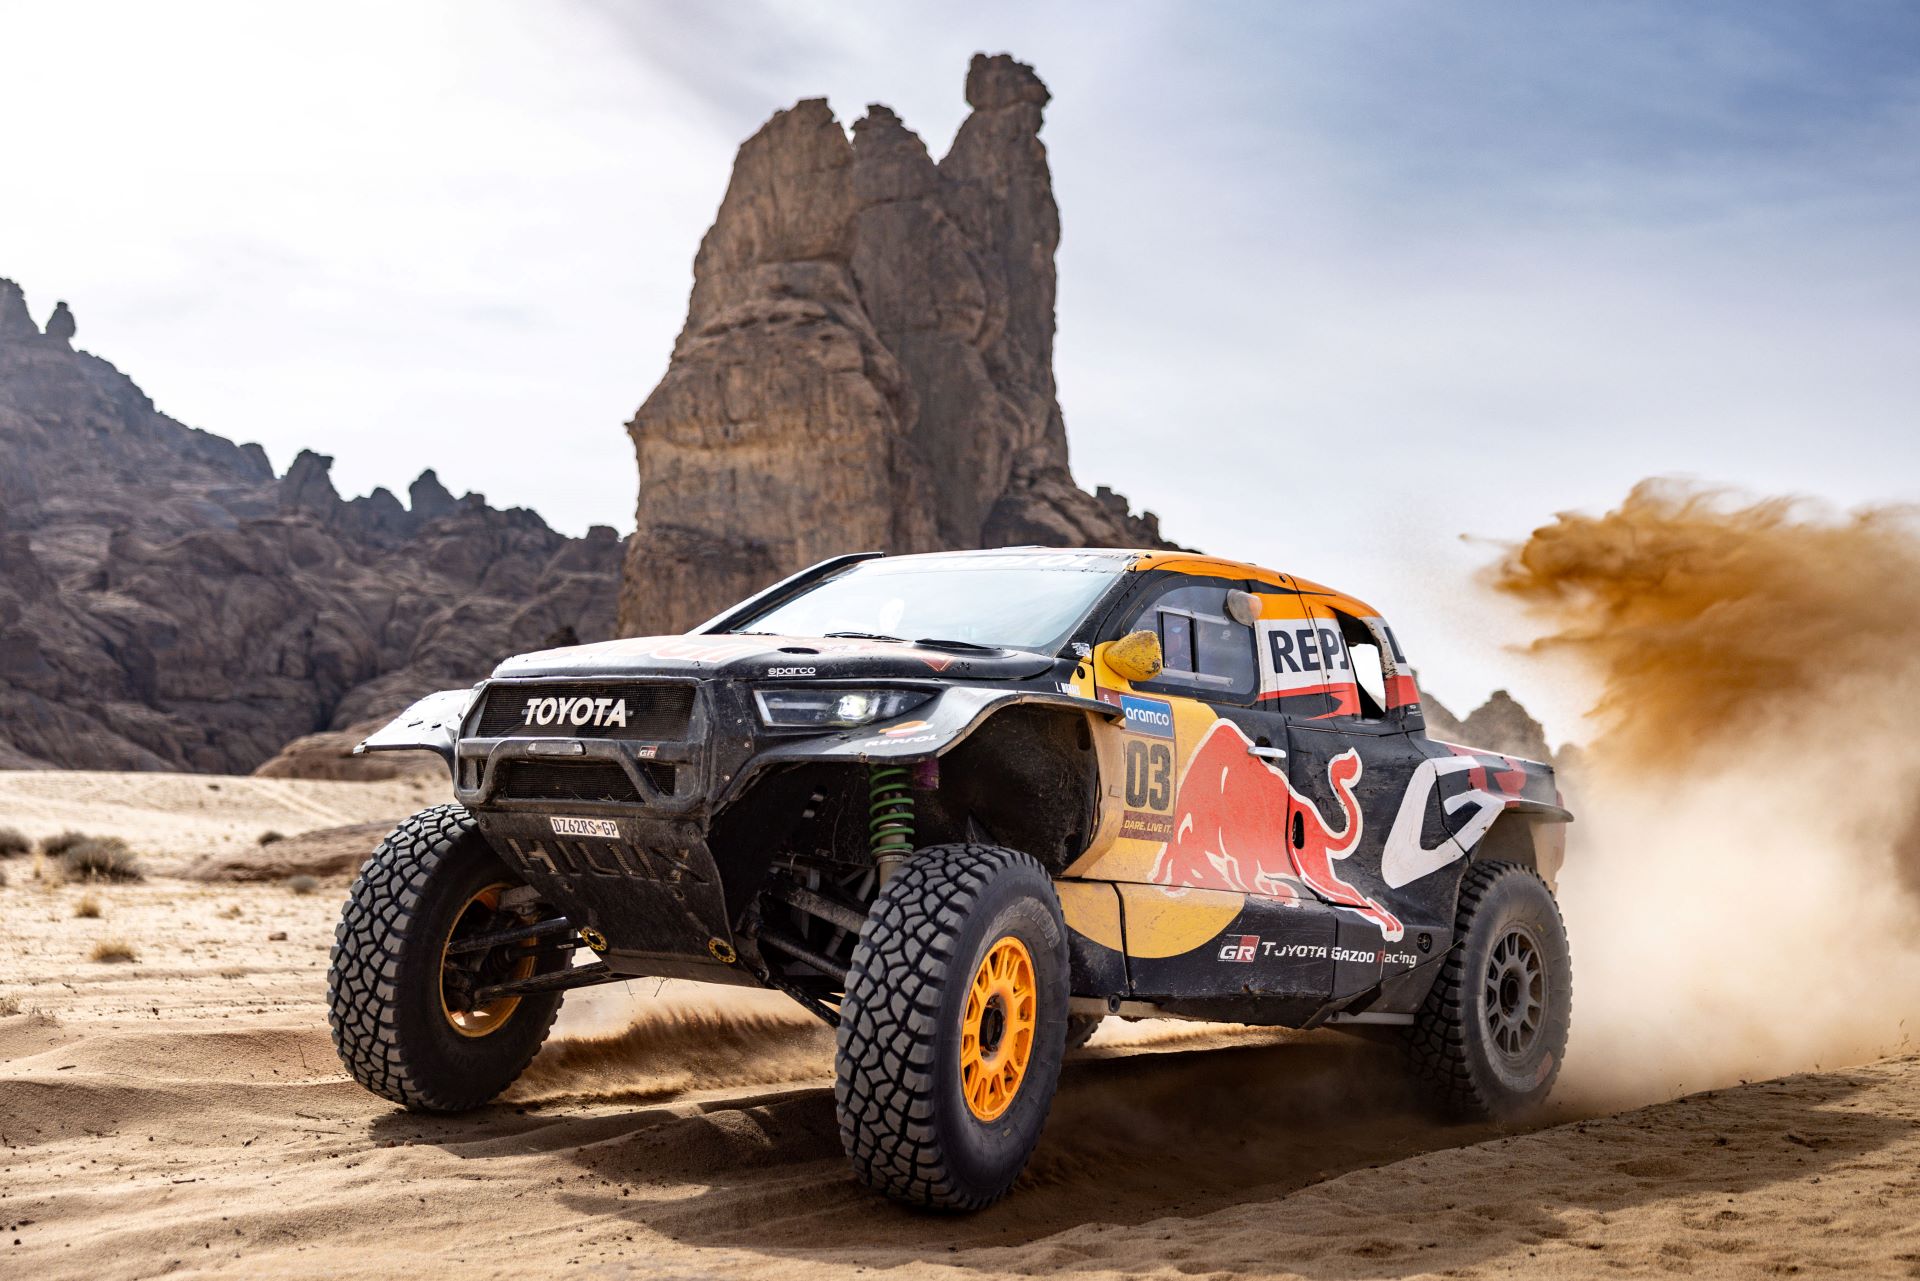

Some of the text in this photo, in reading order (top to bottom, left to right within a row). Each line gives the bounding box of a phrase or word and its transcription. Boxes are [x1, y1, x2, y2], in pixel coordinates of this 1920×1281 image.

[768, 667, 816, 678] sparco
[524, 697, 627, 728] TOYOTA
[1125, 706, 1170, 726] aramco
[639, 749, 656, 758] GR
[1125, 739, 1171, 811] 03
[552, 818, 617, 837] DZ62RS GP
[1124, 819, 1146, 831] DARE.
[1146, 822, 1163, 833] LIVE
[1219, 945, 1255, 961] GR
[1331, 947, 1375, 963] GAZOO
[1376, 950, 1417, 968] Racing
